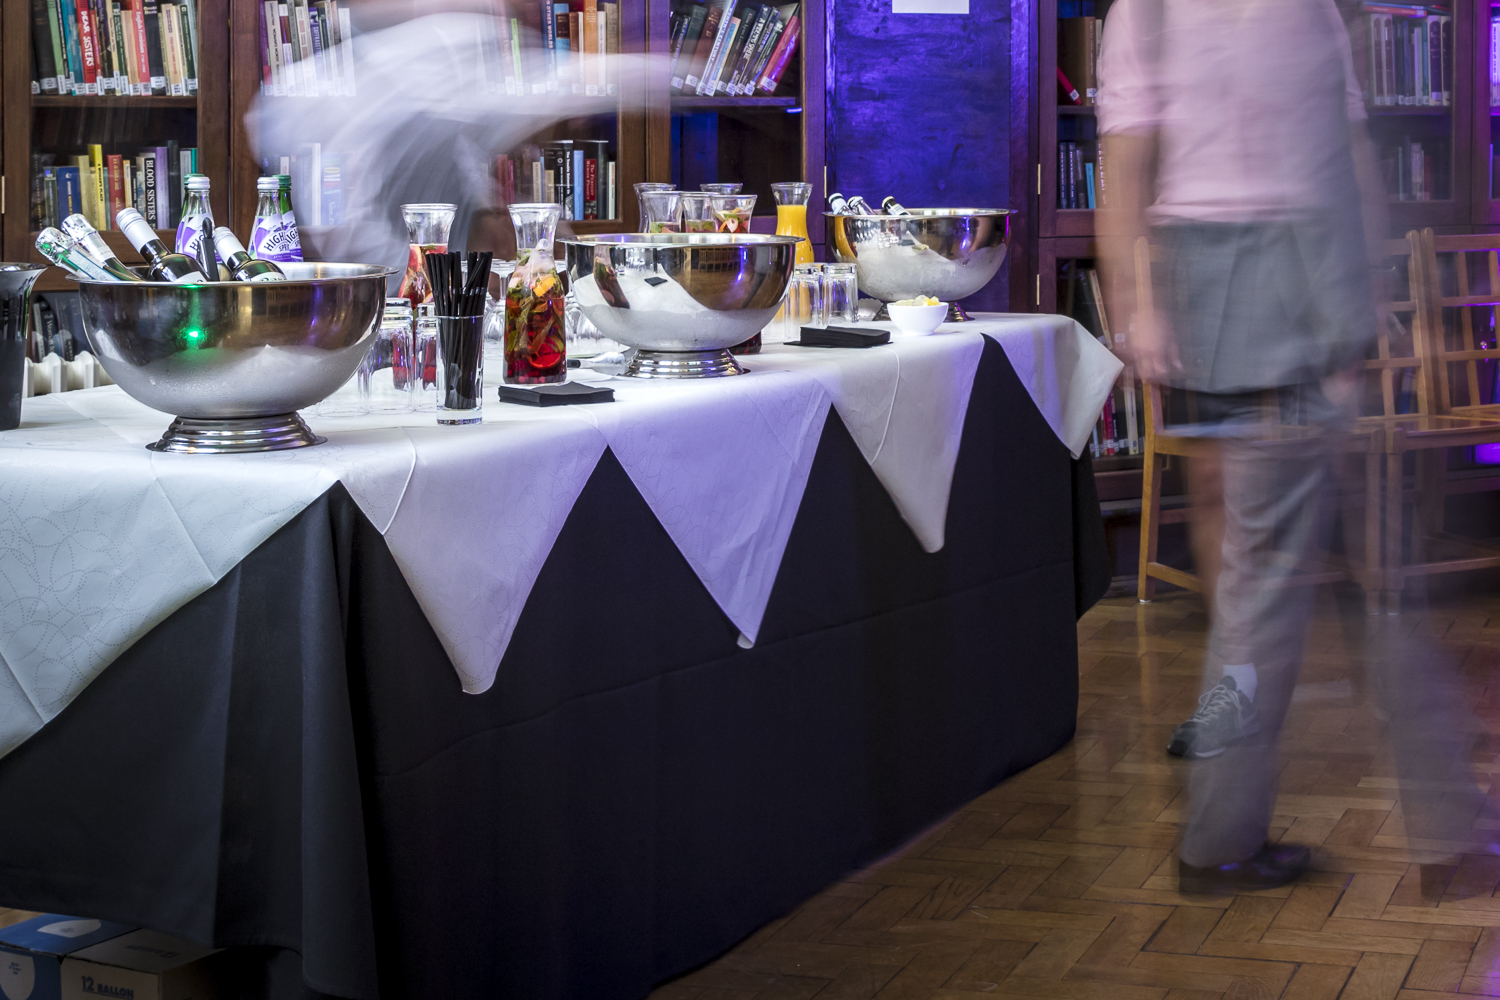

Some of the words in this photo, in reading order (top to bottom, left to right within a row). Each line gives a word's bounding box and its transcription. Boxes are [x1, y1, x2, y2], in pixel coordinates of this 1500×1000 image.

[80, 10, 90, 33] DEAR
[82, 35, 94, 66] SISTERS
[311, 26, 323, 58] SUFFRAGETTES
[145, 159, 154, 187] BLOOD
[146, 189, 156, 220] SISTERS
[81, 975, 94, 991] 12
[97, 983, 134, 999] BALLON
